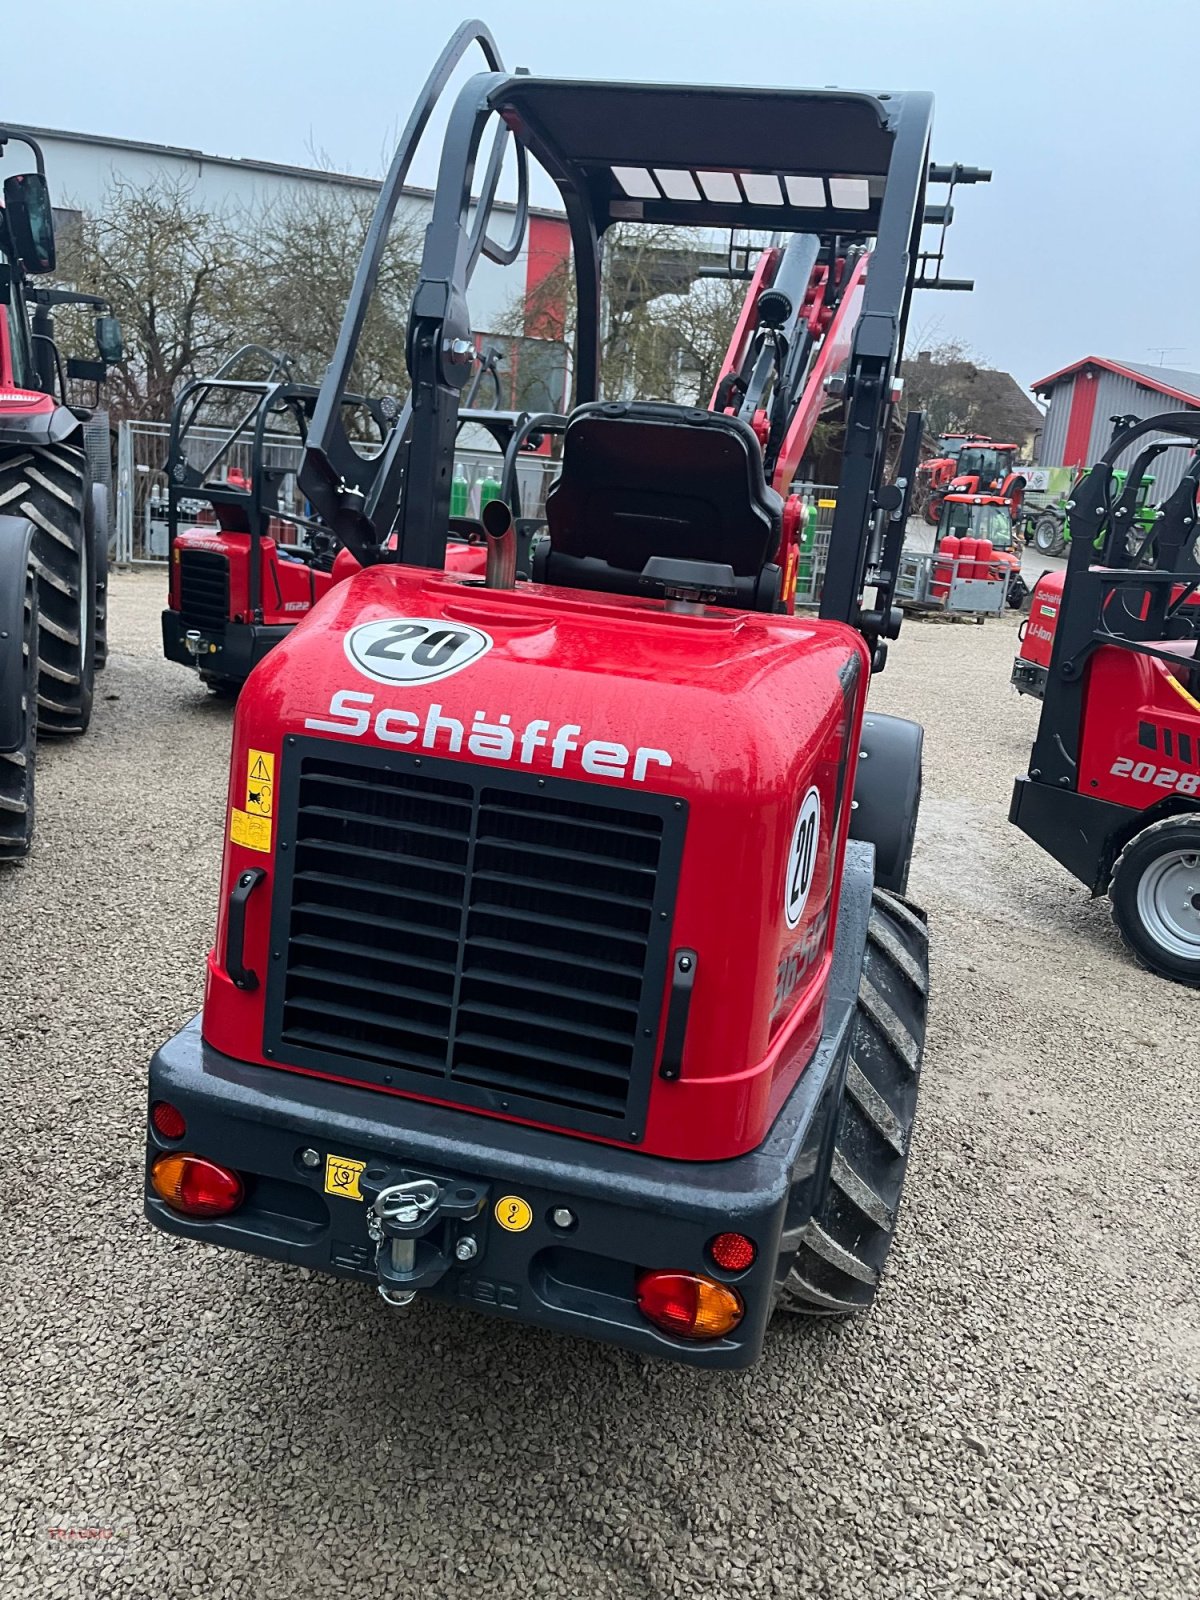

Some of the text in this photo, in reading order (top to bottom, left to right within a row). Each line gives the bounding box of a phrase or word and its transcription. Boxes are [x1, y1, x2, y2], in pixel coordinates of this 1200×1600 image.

[285, 602, 310, 611] 1622
[364, 624, 470, 666] 20
[1028, 623, 1052, 641] Li-Ion
[304, 689, 673, 782] Schäffer
[1110, 756, 1200, 795] 2028
[790, 811, 816, 907] 20
